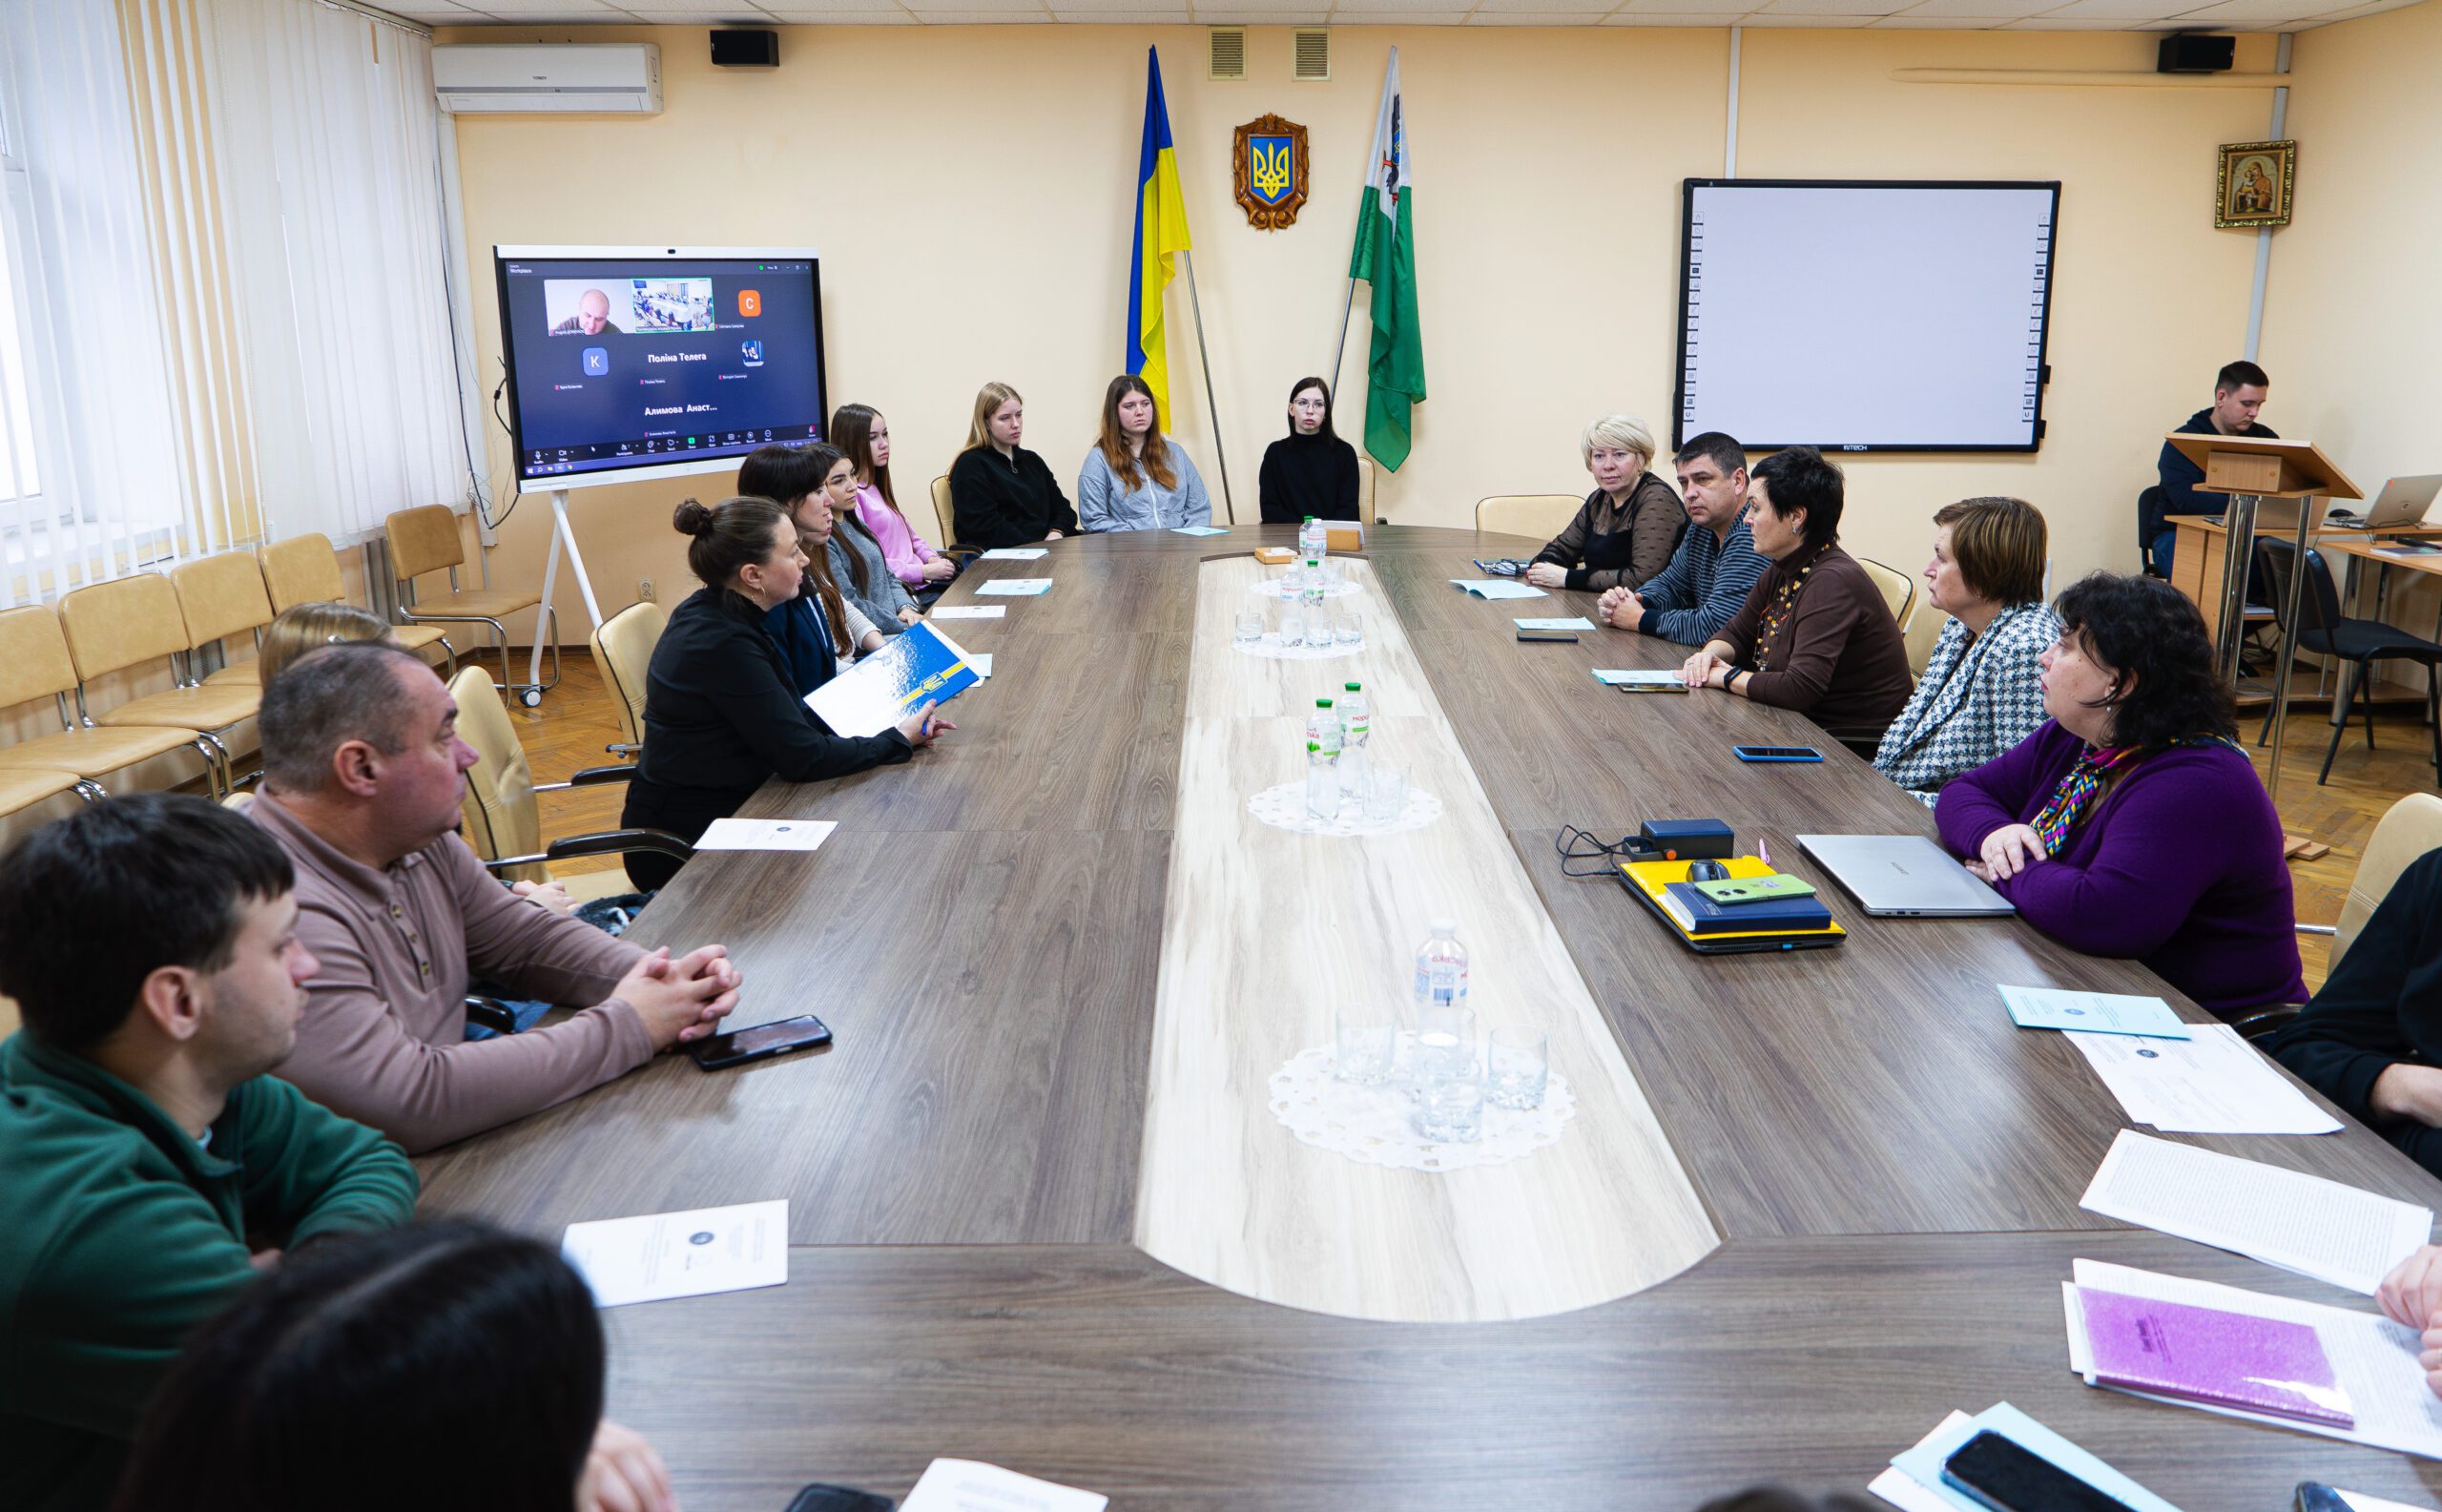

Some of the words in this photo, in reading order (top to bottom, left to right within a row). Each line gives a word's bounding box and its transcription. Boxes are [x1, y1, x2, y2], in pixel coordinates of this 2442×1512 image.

[648, 353, 678, 363] Поліна
[678, 352, 707, 362] Телега
[644, 406, 684, 416] Алимова
